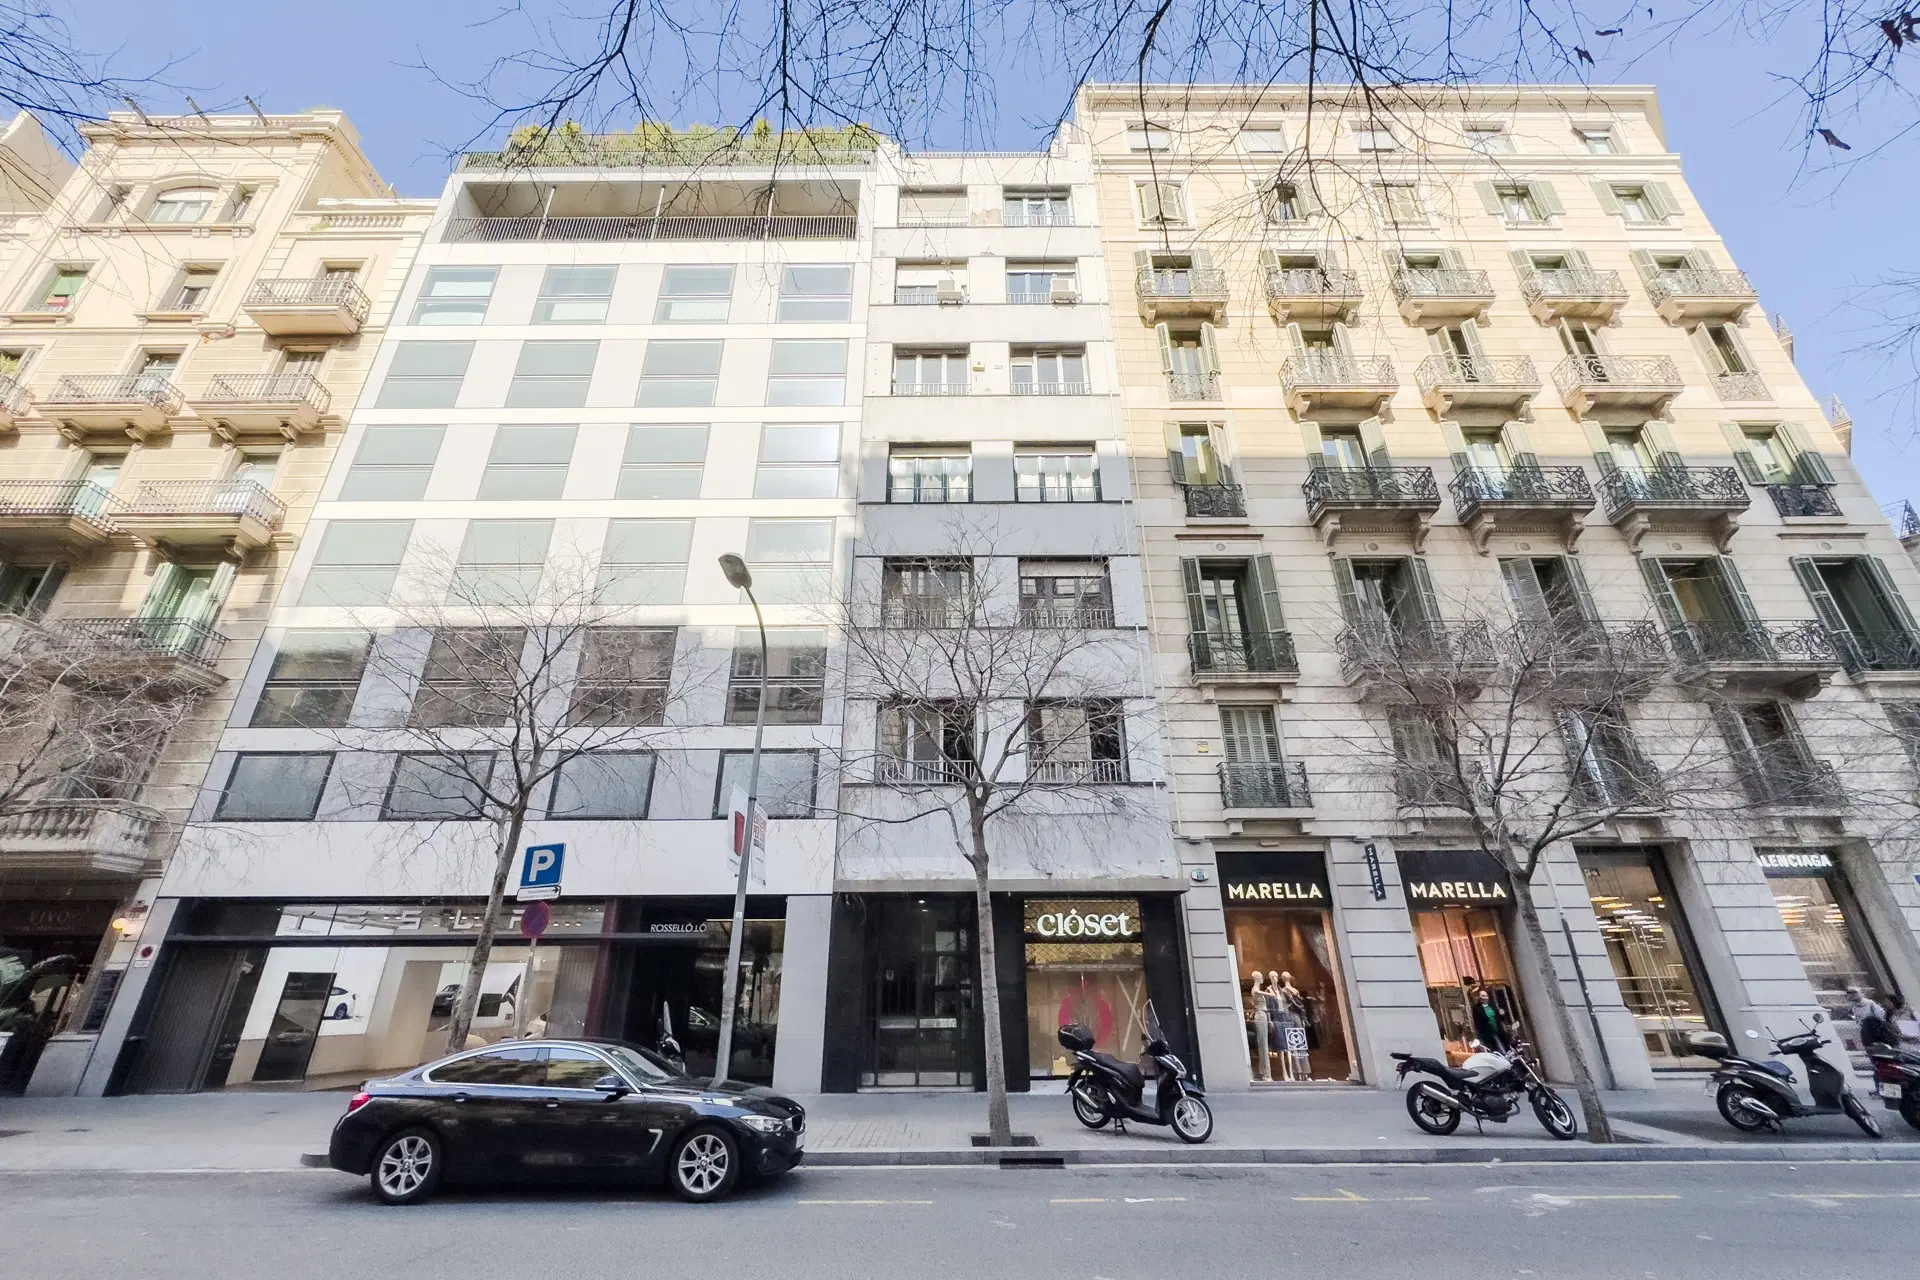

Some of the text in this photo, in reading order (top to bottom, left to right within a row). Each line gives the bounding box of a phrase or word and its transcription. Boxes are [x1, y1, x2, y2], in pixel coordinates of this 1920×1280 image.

[528, 849, 556, 882] P
[1367, 847, 1383, 898] MARELLA
[1227, 882, 1323, 900] MARELLA
[1409, 881, 1507, 898] MARELLA
